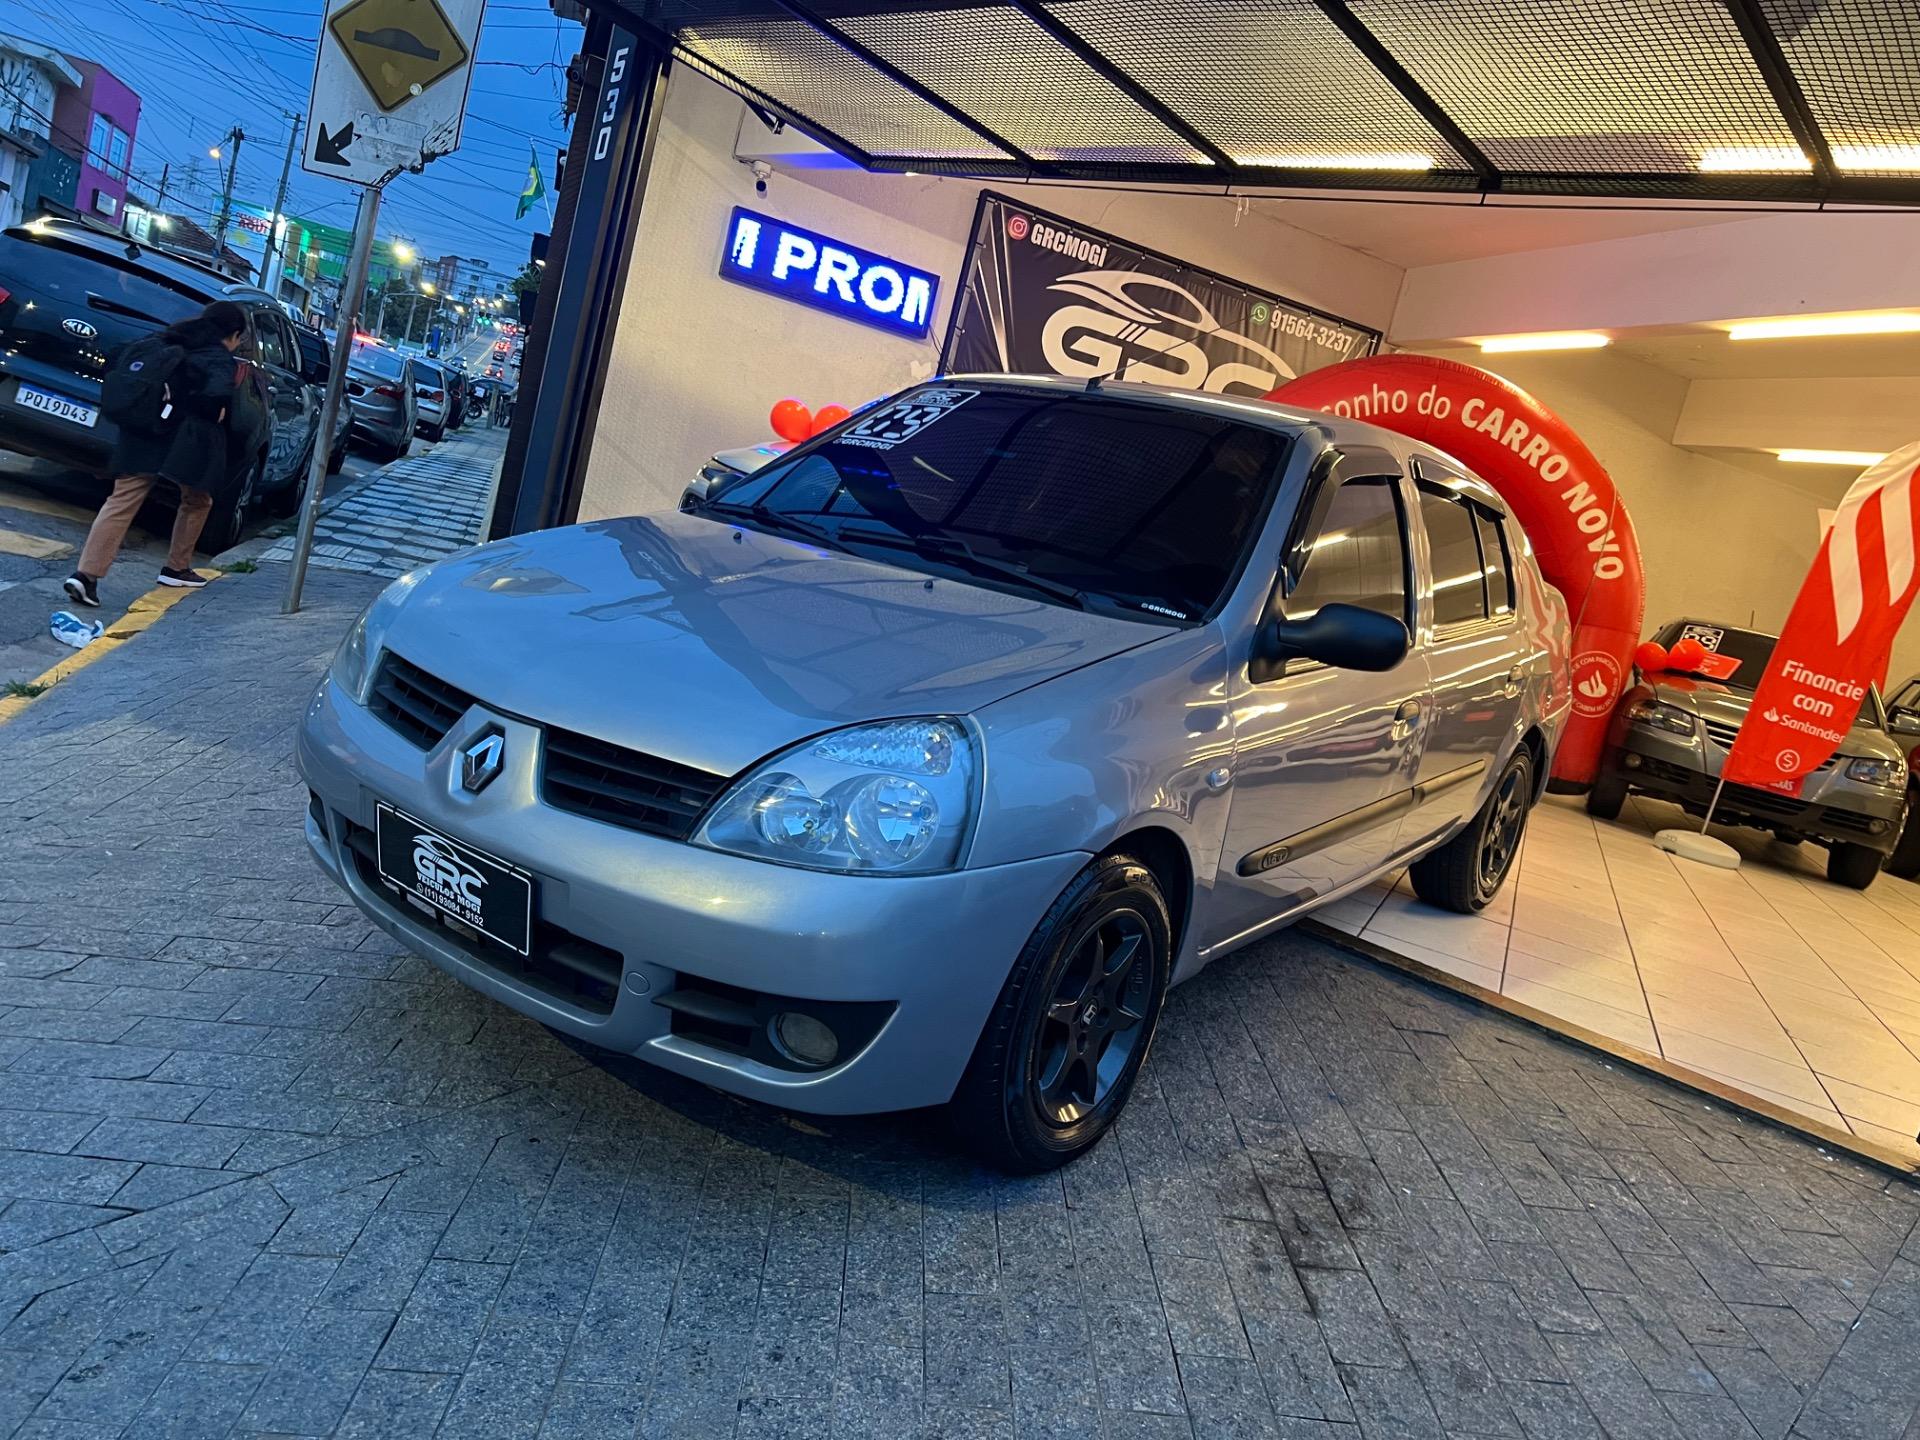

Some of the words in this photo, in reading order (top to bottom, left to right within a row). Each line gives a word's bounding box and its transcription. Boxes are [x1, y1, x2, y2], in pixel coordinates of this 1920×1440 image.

[595, 47, 629, 160] 530
[1030, 223, 1108, 268] GRCMOGI
[65, 320, 91, 336] KIA
[1270, 309, 1353, 353] 91564-3237
[23, 390, 89, 422] PQI9D43
[1417, 384, 1451, 420] do
[1460, 398, 1569, 482] CARRO
[1561, 481, 1625, 580] NOVO
[1781, 659, 1865, 701] Financie
[1792, 693, 1834, 718] com
[1779, 714, 1846, 744] Santander
[413, 847, 482, 907] GRC
[416, 871, 455, 900] VEICULOS
[457, 895, 481, 914] MOGI
[424, 886, 438, 903] (11)
[465, 908, 484, 927] 9152
